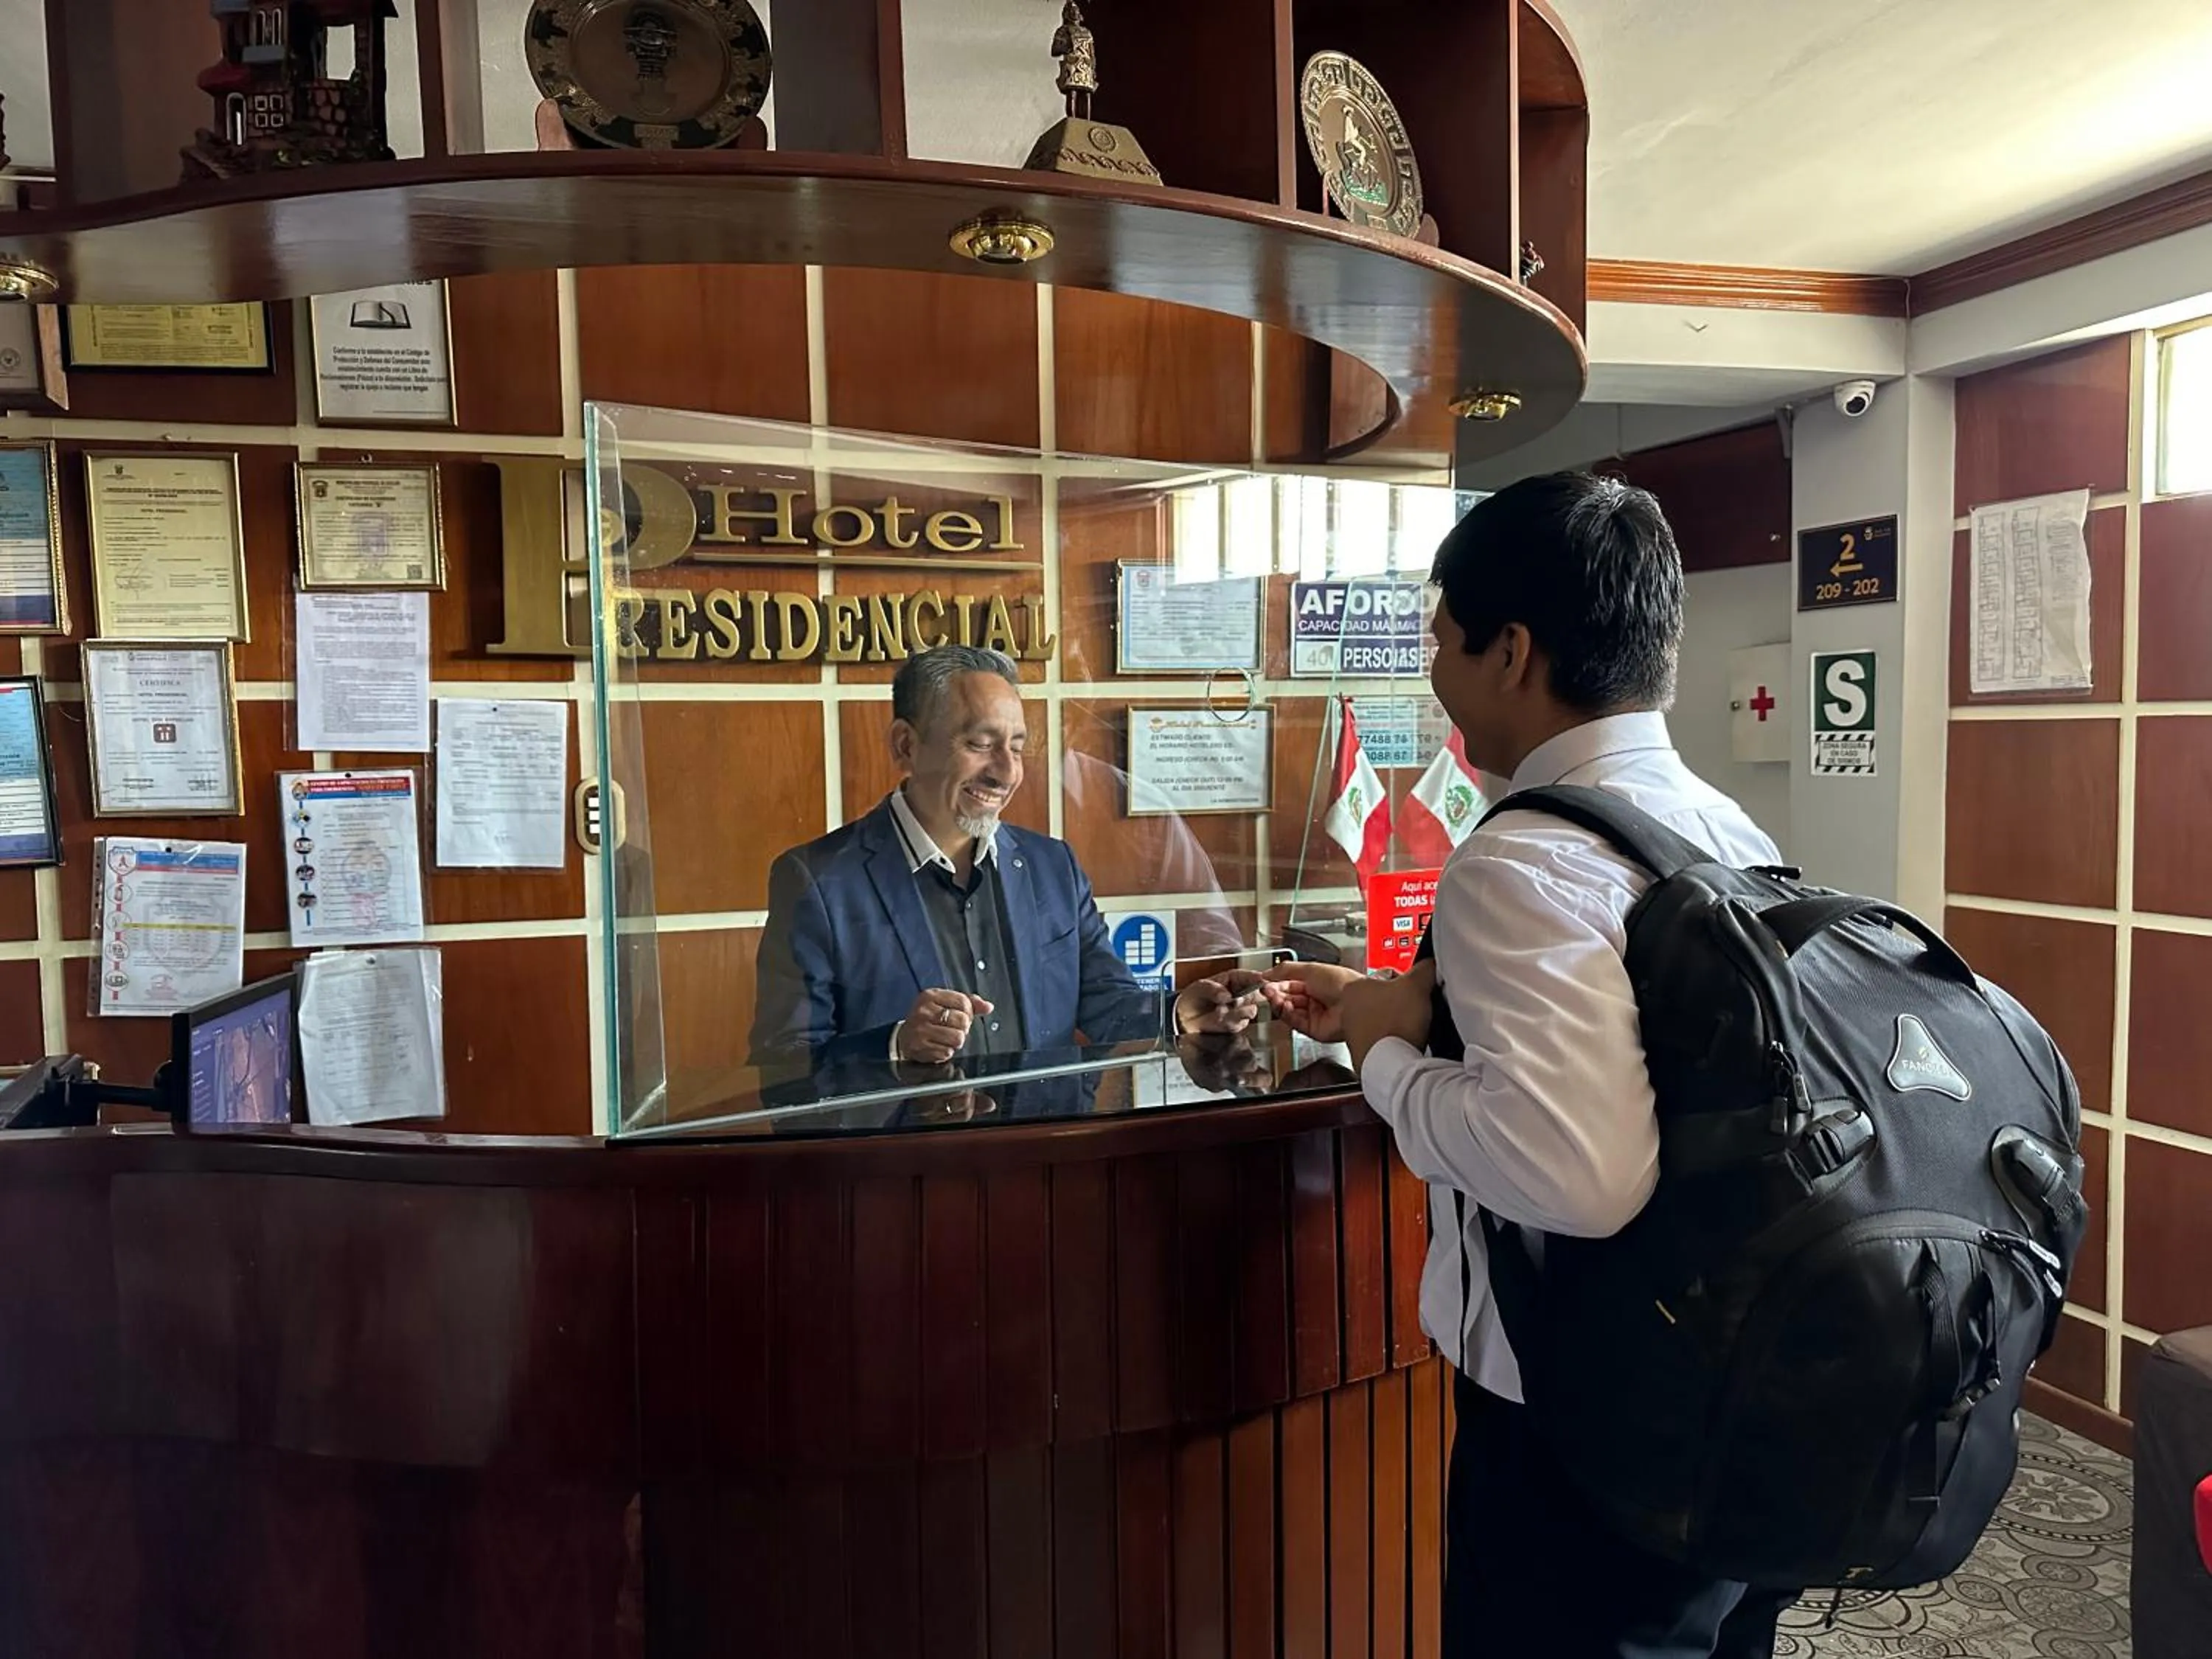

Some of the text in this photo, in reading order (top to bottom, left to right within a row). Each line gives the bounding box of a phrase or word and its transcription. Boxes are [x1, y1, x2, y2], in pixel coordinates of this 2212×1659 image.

[697, 484, 1025, 553] Hotel
[1839, 533, 1856, 561] 2
[1816, 582, 1842, 600] 209
[1853, 577, 1879, 597] 202
[1823, 658, 1867, 726] S
[1402, 880, 1422, 893] Aquí
[1394, 894, 1428, 908] TODAS
[1396, 919, 1411, 928] VISA
